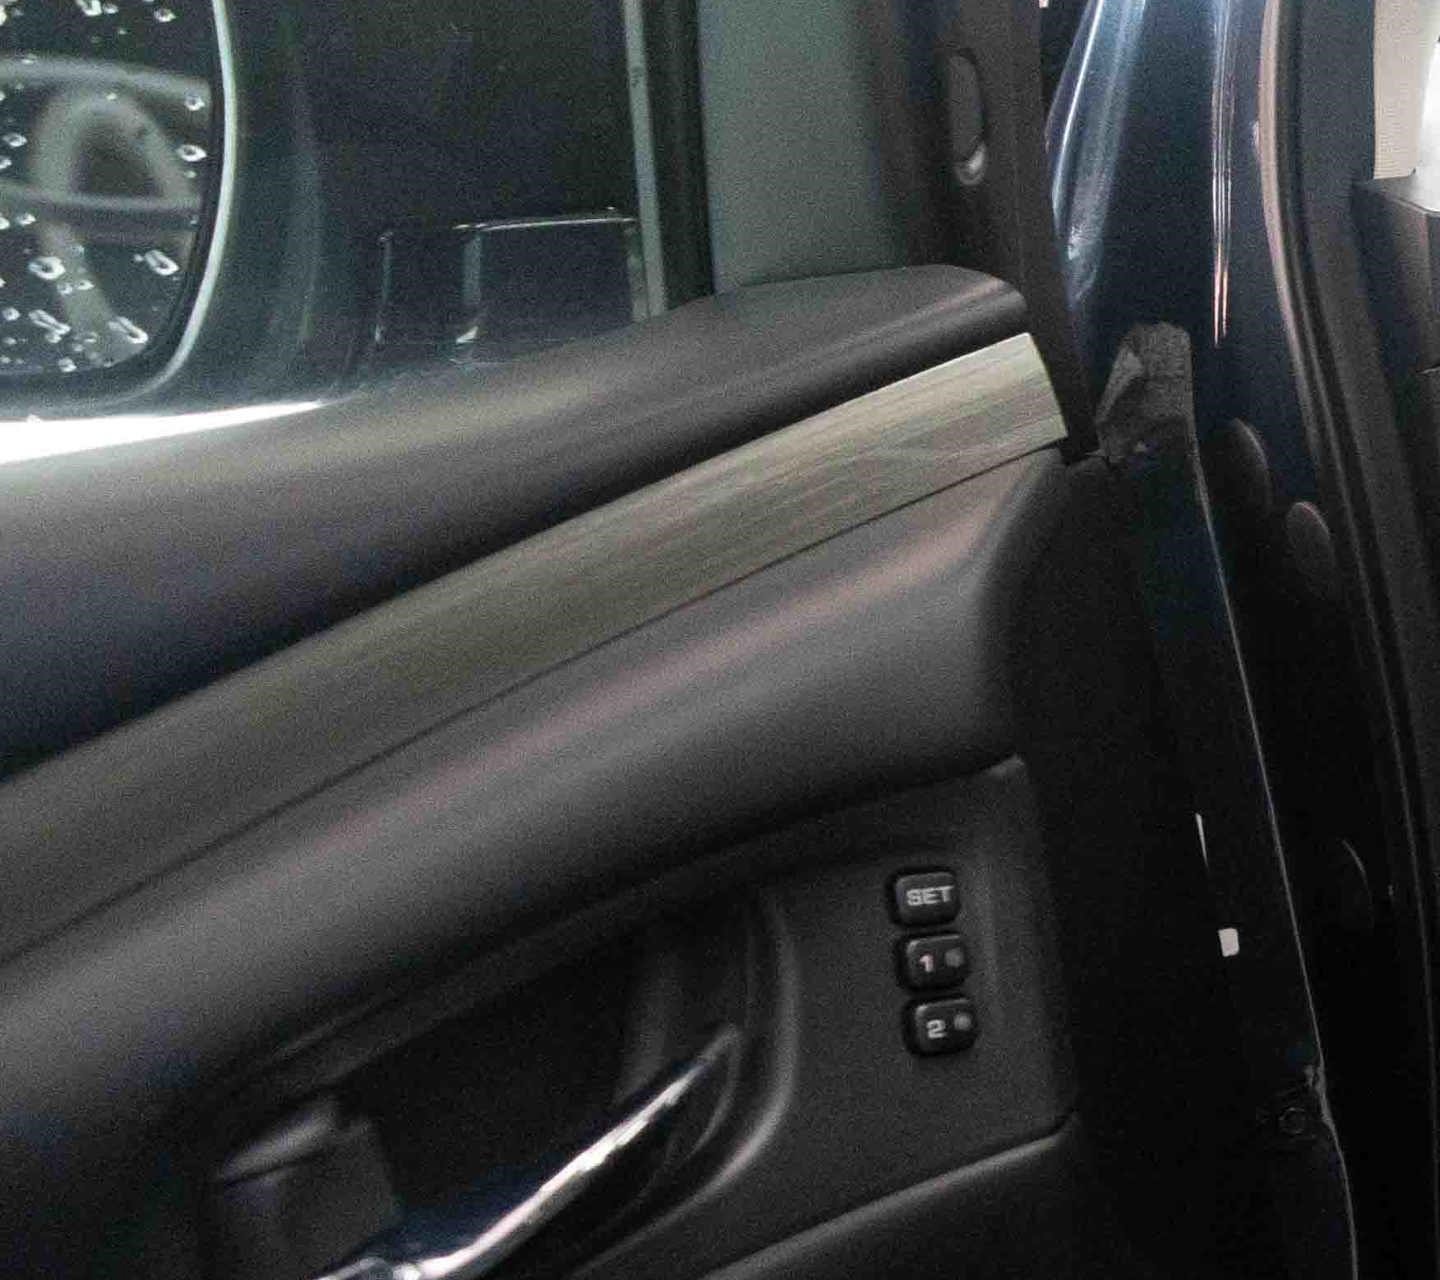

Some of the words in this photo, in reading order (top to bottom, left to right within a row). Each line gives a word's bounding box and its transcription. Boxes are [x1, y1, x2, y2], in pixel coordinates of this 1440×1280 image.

[906, 885, 955, 906] SET
[919, 953, 934, 973] 1
[926, 1019, 946, 1039] 2
